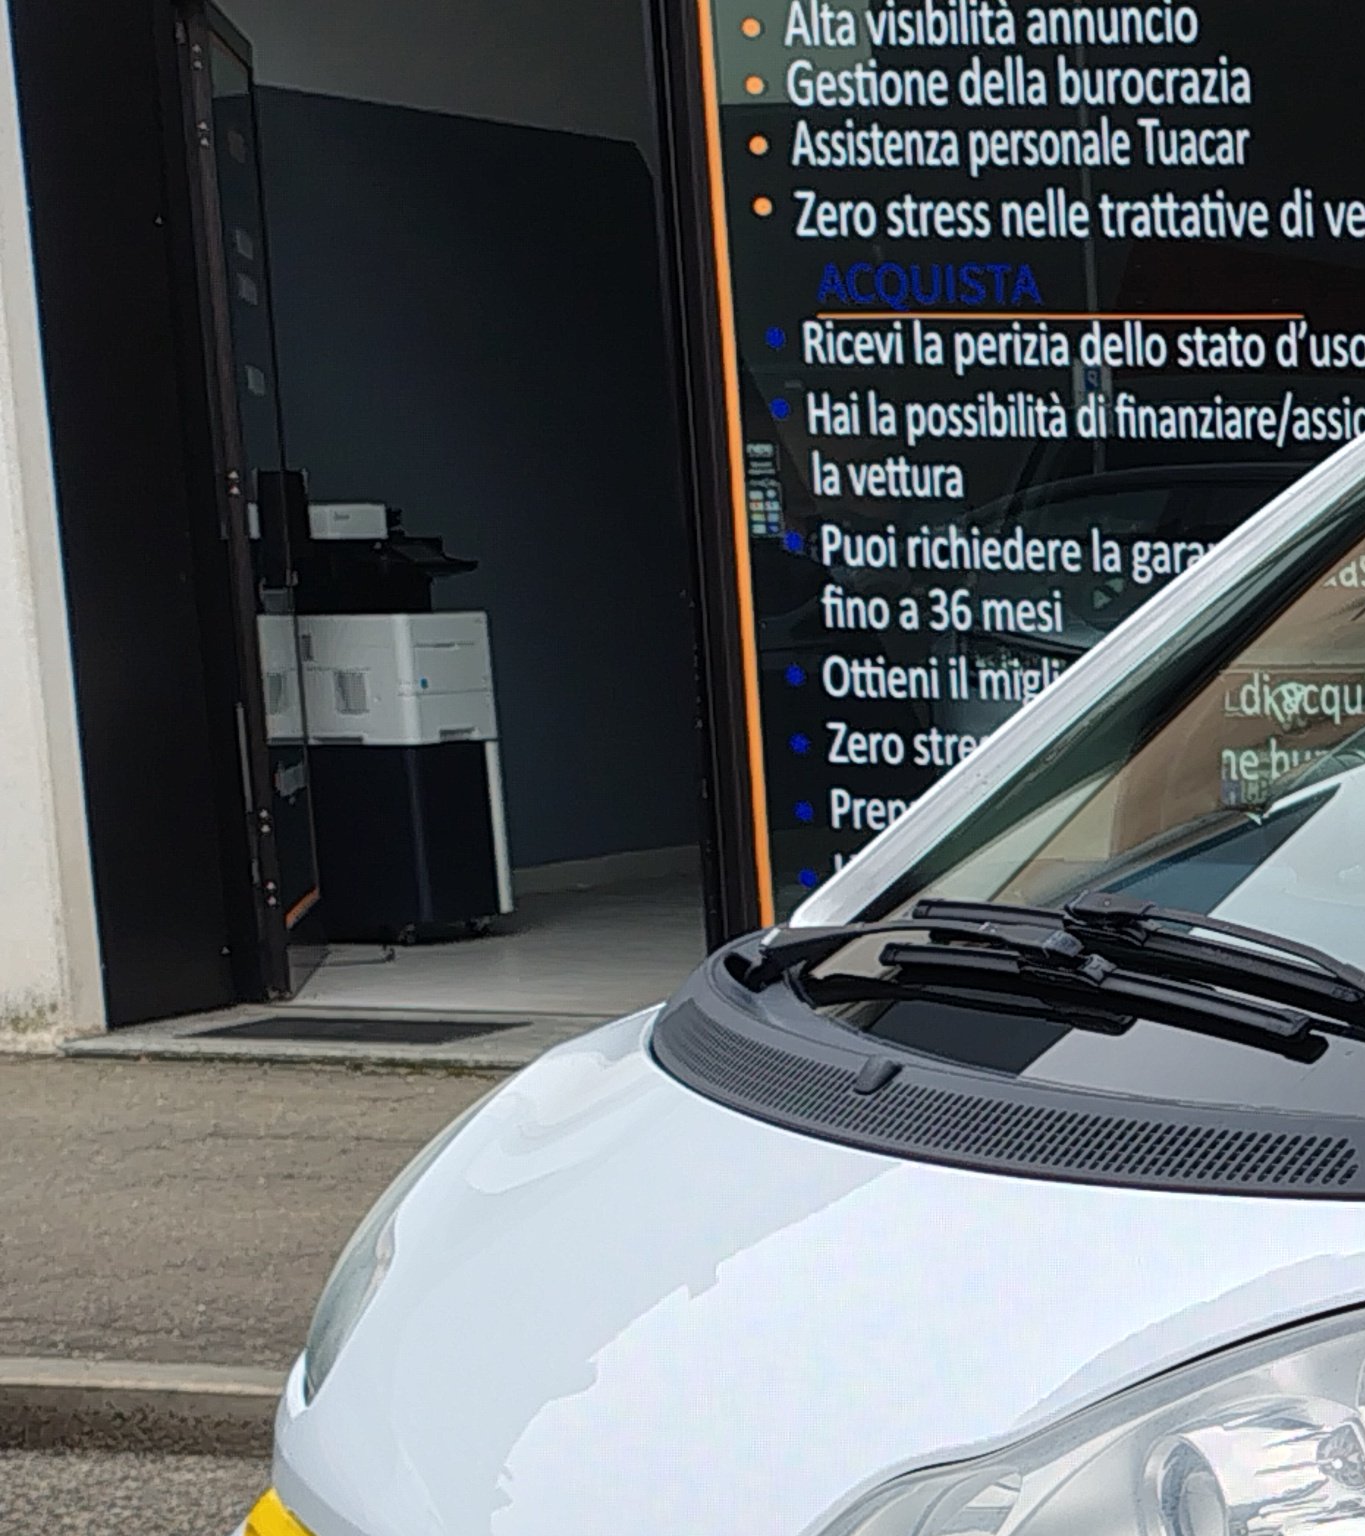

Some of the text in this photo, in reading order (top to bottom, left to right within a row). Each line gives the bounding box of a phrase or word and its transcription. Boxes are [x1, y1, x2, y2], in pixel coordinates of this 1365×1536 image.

[784, 0, 856, 46] Alta
[1026, 0, 1199, 45] annuncio
[786, 54, 1251, 106] Gestione della burocrazia
[791, 115, 1250, 178] Assistenza personale Tuacar
[793, 190, 877, 238] Zero
[886, 194, 991, 238] stress
[1001, 186, 1090, 237] nelle
[1098, 189, 1270, 238] trattative
[1279, 186, 1315, 238] di
[817, 261, 1041, 311] ACQUISTA
[802, 320, 903, 365] Ricevi
[912, 319, 943, 365] la
[954, 320, 1069, 377] perizia
[1079, 320, 1168, 367] dello
[1176, 326, 1266, 368] stato
[806, 391, 860, 436] Hai
[867, 389, 897, 436] la
[906, 391, 1068, 447] possibilità
[1076, 393, 1107, 439] di
[812, 450, 841, 496] la
[848, 455, 964, 498] vettura
[821, 524, 897, 568] Puoi
[907, 525, 1081, 571] richiedere
[1091, 528, 1122, 573] la
[1131, 540, 1218, 585] gara
[822, 585, 1063, 633] fino a 36 mesi
[822, 656, 940, 699] Ottieni
[949, 657, 969, 699] il
[825, 722, 904, 765] Zero
[912, 727, 990, 766] stre
